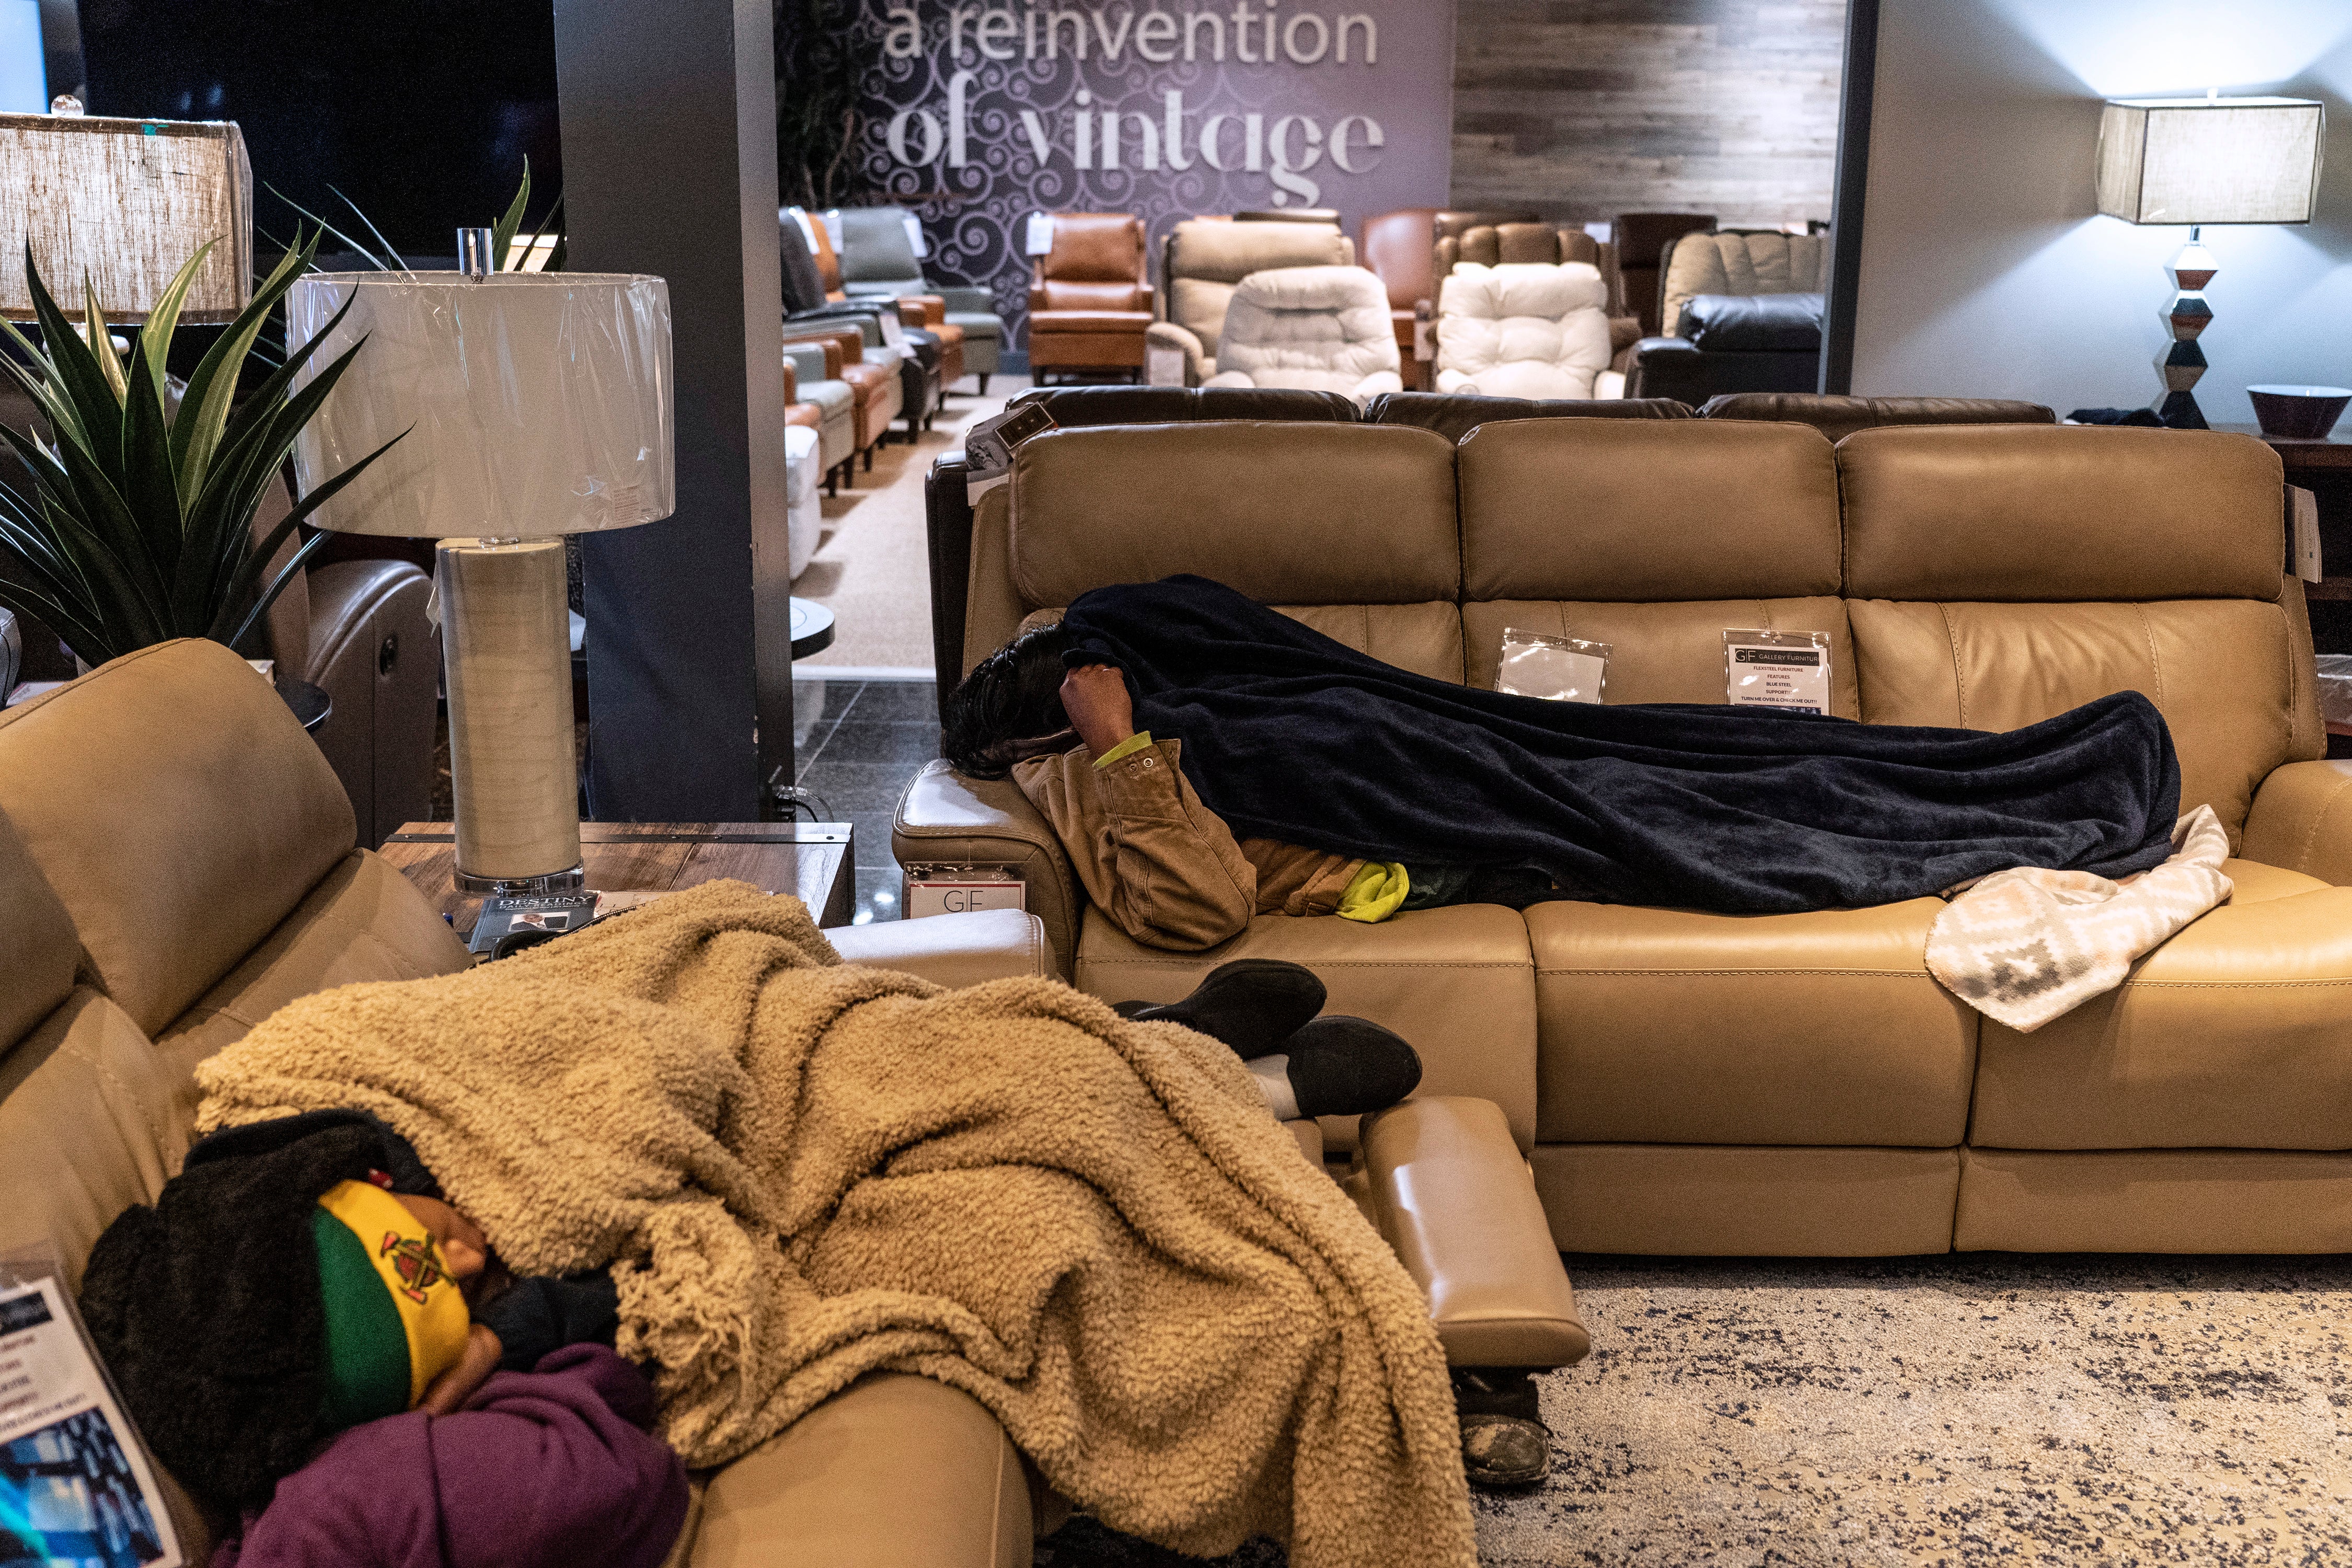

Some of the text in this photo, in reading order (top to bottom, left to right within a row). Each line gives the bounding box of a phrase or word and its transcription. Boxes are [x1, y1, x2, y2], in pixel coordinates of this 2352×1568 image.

[884, 0, 1378, 63] a reinvention
[887, 70, 1385, 208] of vintage
[499, 896, 593, 906] DESTINY
